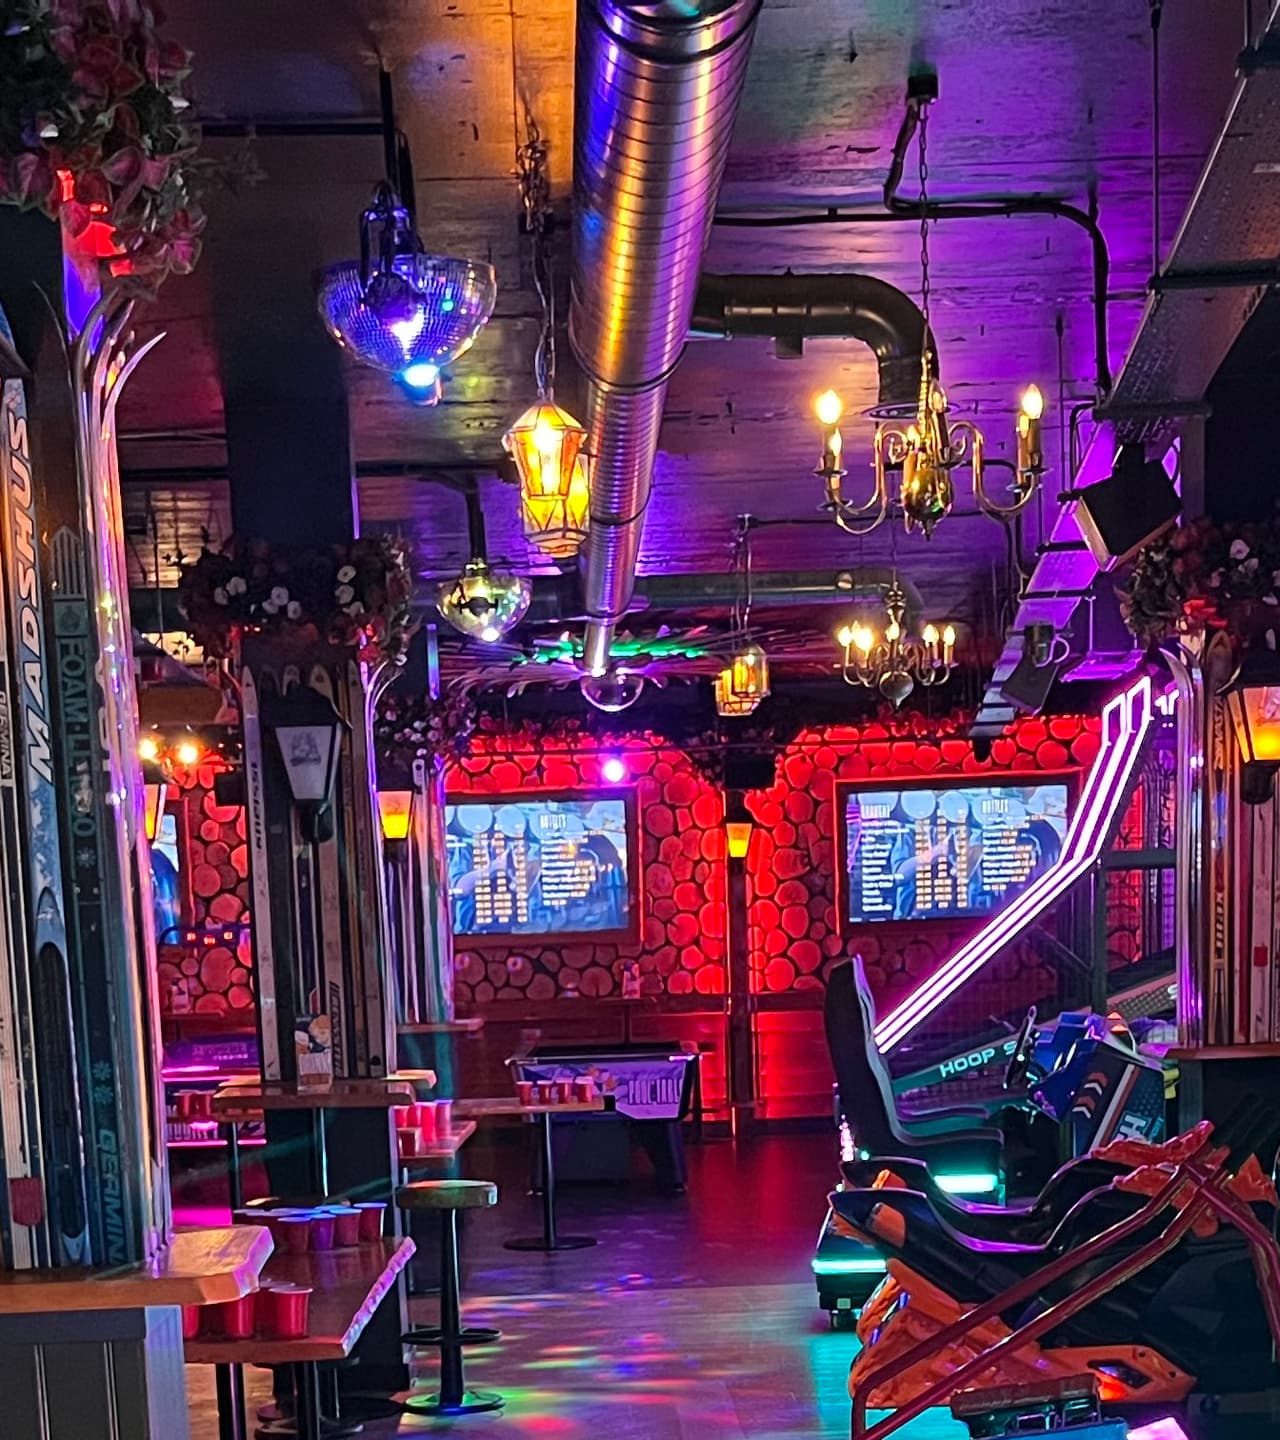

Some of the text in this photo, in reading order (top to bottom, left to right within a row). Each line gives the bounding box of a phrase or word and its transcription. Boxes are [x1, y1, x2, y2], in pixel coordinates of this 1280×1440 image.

[8, 407, 52, 784] MADSHUS
[939, 1047, 996, 1078] HOOP
[98, 1128, 124, 1265] GERMIN
